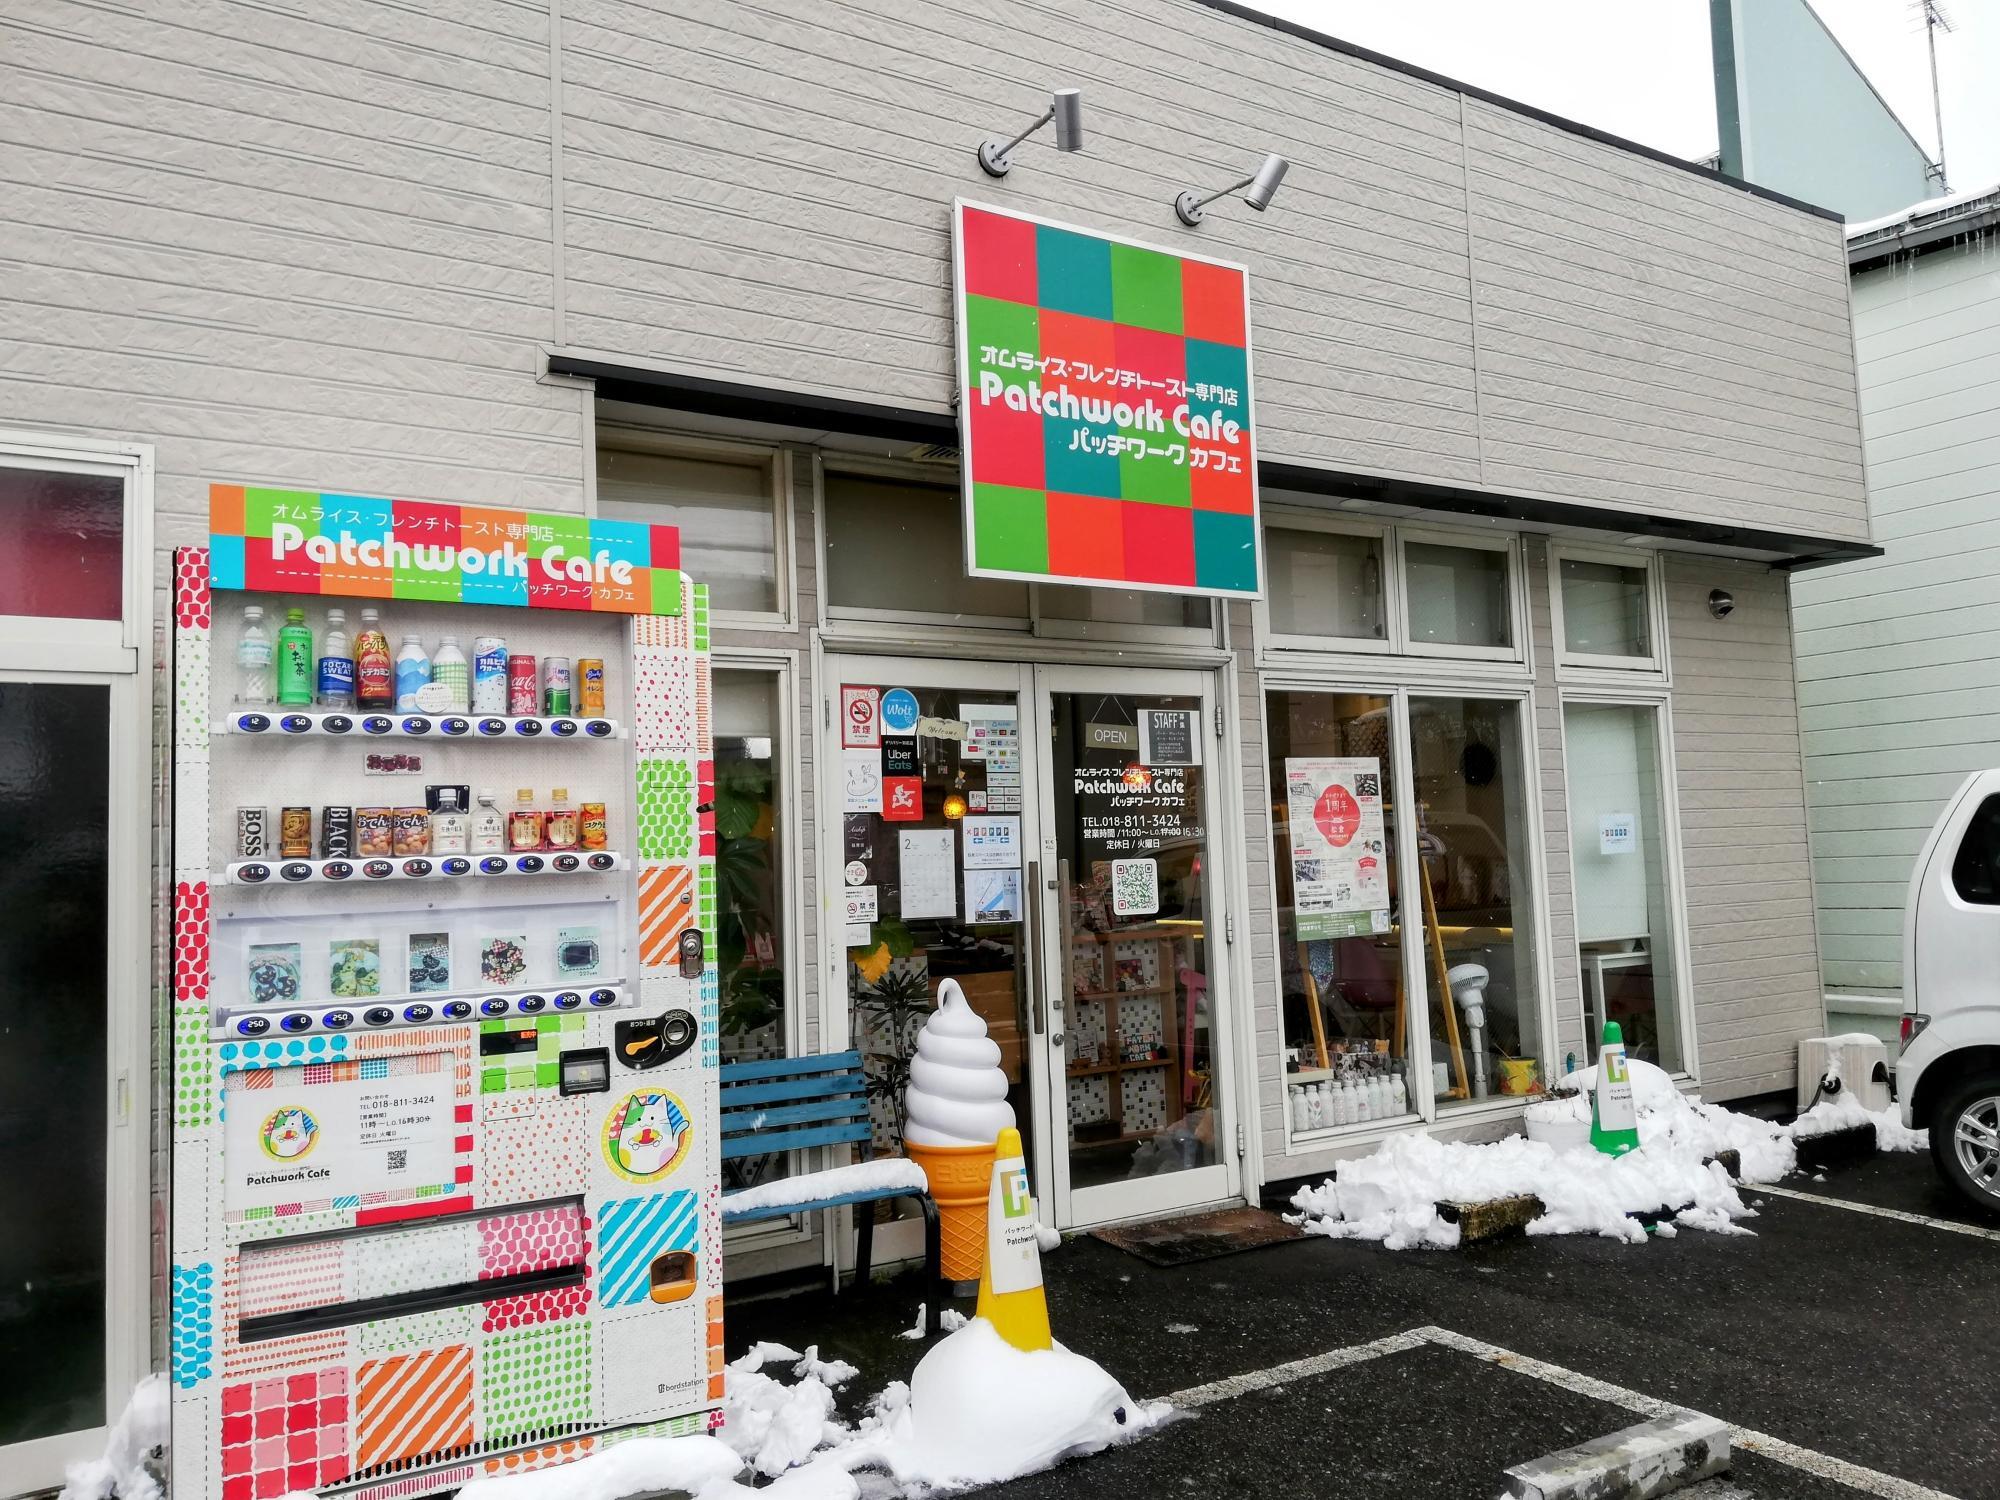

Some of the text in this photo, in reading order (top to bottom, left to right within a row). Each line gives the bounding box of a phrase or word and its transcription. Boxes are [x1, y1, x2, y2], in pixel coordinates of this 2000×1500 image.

[980, 345, 1238, 407] オムライス・フレンチトースト専門店
[980, 370, 1240, 445] Patchwork Cafe
[1068, 427, 1242, 474] パッチワーク カフェ
[272, 503, 553, 542] オムライス・フレンチトースト専門店
[272, 522, 634, 586] Patchwork Cafe
[886, 703, 912, 716] Wolt
[1153, 712, 1178, 729] STAFF
[852, 725, 871, 734] 禁煙
[1094, 729, 1128, 744] OPEN
[888, 749, 912, 760] Uber
[888, 760, 912, 770] Eats
[1074, 778, 1185, 794] Patchwork Cafe
[1110, 795, 1185, 807] パッチワーク カフェ
[1325, 799, 1349, 813] 1周年
[245, 809, 262, 856] BOSS
[329, 807, 349, 859] BLACK
[1083, 828, 1115, 839] 営業時間
[904, 838, 911, 850] 2
[1106, 840, 1130, 850] 定休日
[1137, 838, 1160, 849] 火曜日
[372, 1095, 434, 1109] 018-811-3424
[246, 1171, 305, 1186] Patchwork
[307, 1168, 330, 1179] Cafe
